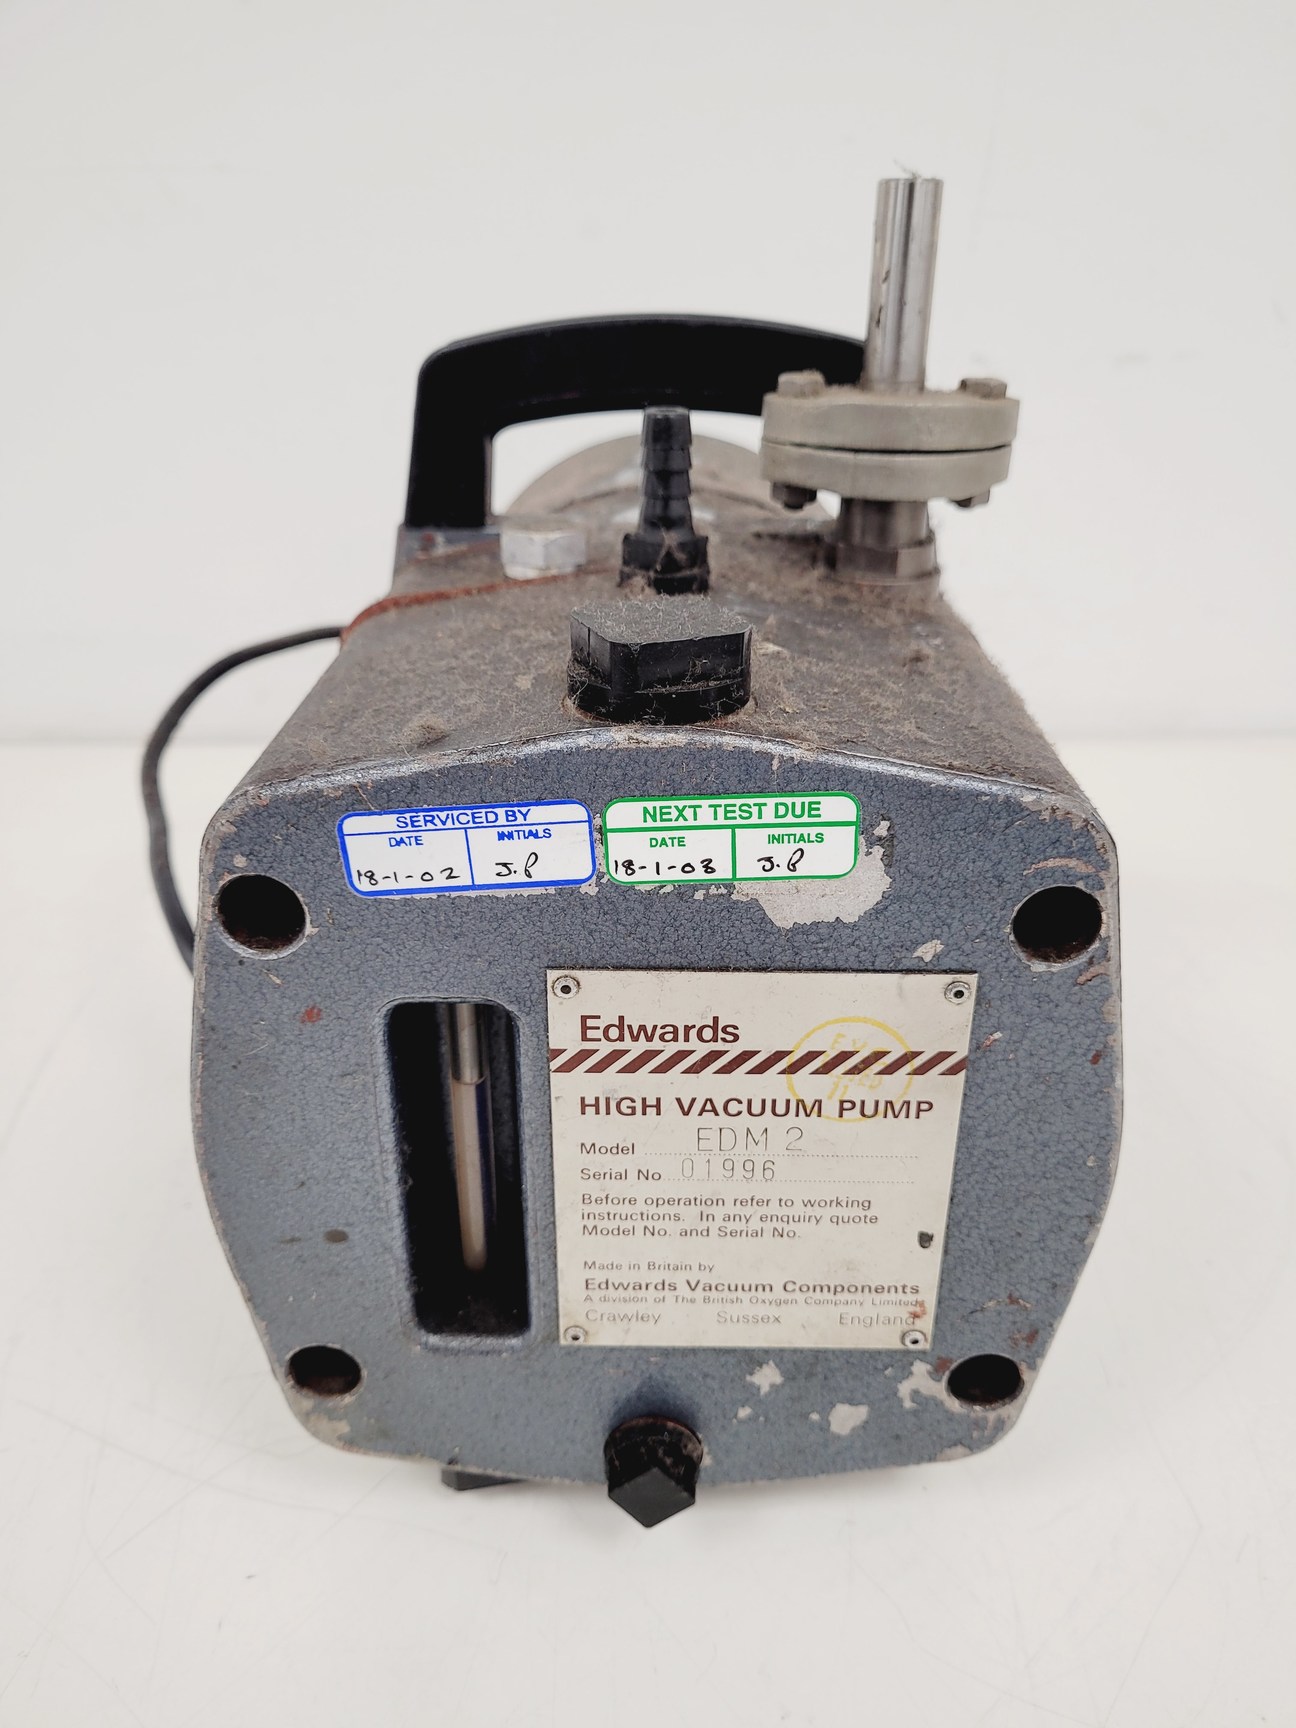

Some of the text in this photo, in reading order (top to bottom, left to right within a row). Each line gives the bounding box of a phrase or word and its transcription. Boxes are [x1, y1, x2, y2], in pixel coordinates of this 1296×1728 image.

[395, 808, 532, 829] SERVICED BY
[642, 800, 822, 823] NEXT TEST DUE
[388, 835, 424, 848] DATE
[497, 828, 552, 841] INITIALS
[649, 836, 686, 848] DATE
[767, 832, 825, 845] INITIALS
[356, 867, 461, 886] 18-1-02
[580, 1014, 741, 1044] Edwards
[580, 1096, 935, 1120] HIGH VACUUM PUMP
[580, 1126, 805, 1156] Model EDM 2
[580, 1167, 629, 1182] Serial
[680, 1157, 777, 1181] 01996
[581, 1193, 873, 1211] Before operation refer to working
[581, 1209, 880, 1227] instructions. In any enquiry quote
[582, 1224, 802, 1239] Model No. and Serial No.
[583, 1260, 716, 1274] Made in Britain by
[584, 1277, 921, 1297] Edwards Vacuum Components
[583, 1294, 919, 1308] A division of The British Oxygen Company Limited
[585, 1309, 917, 1328] Crawley Sussex England
